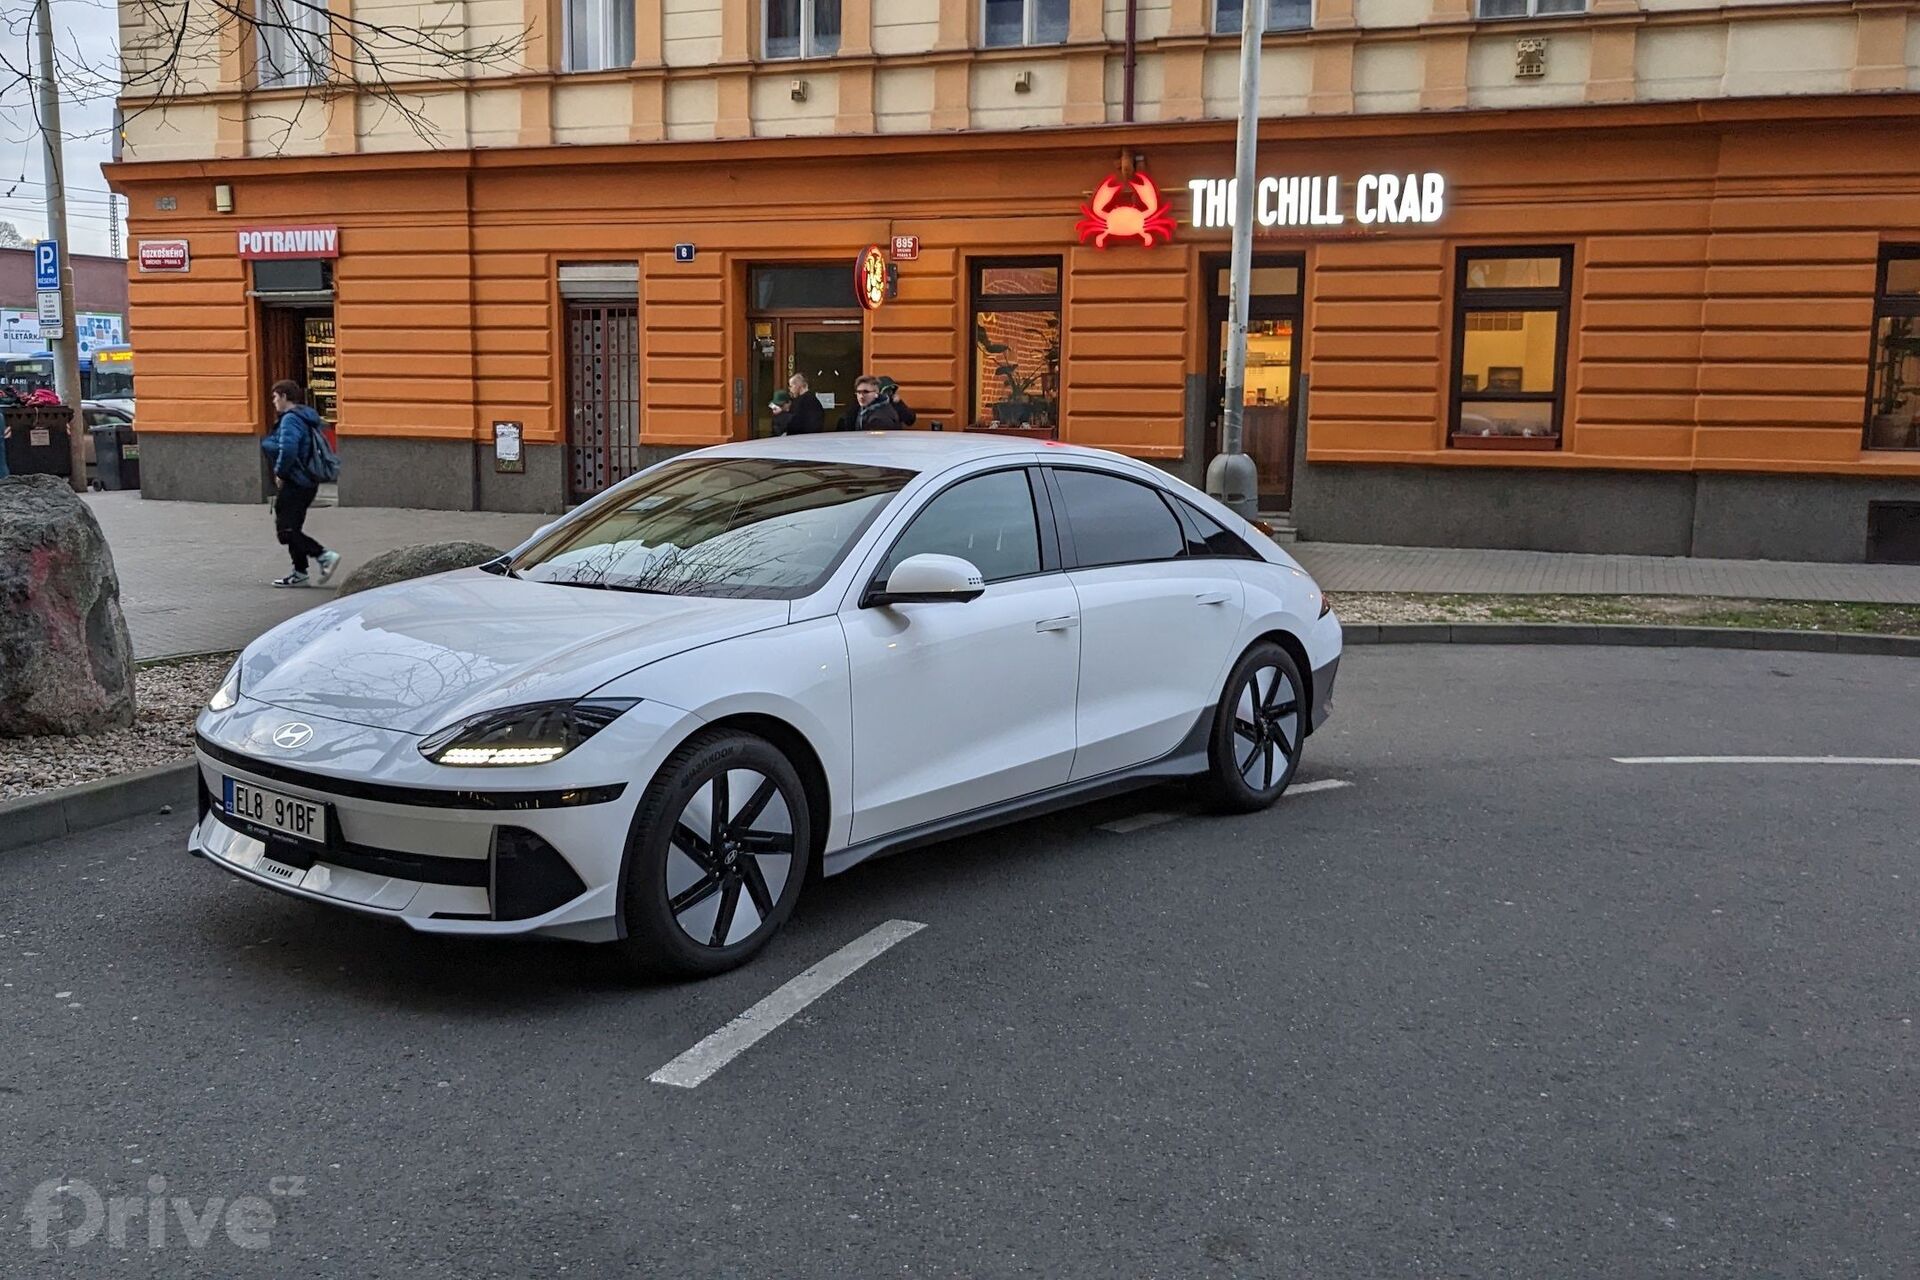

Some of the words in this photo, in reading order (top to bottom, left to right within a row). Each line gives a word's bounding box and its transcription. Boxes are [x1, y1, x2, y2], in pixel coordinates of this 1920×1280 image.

[1257, 175, 1344, 227] CHILL
[1356, 172, 1446, 225] CRAB
[239, 229, 337, 253] POTRAVINY
[681, 247, 688, 258] 6
[896, 238, 914, 248] 895
[40, 246, 54, 274] P
[236, 786, 263, 820] EL8
[274, 798, 317, 835] 91BF
